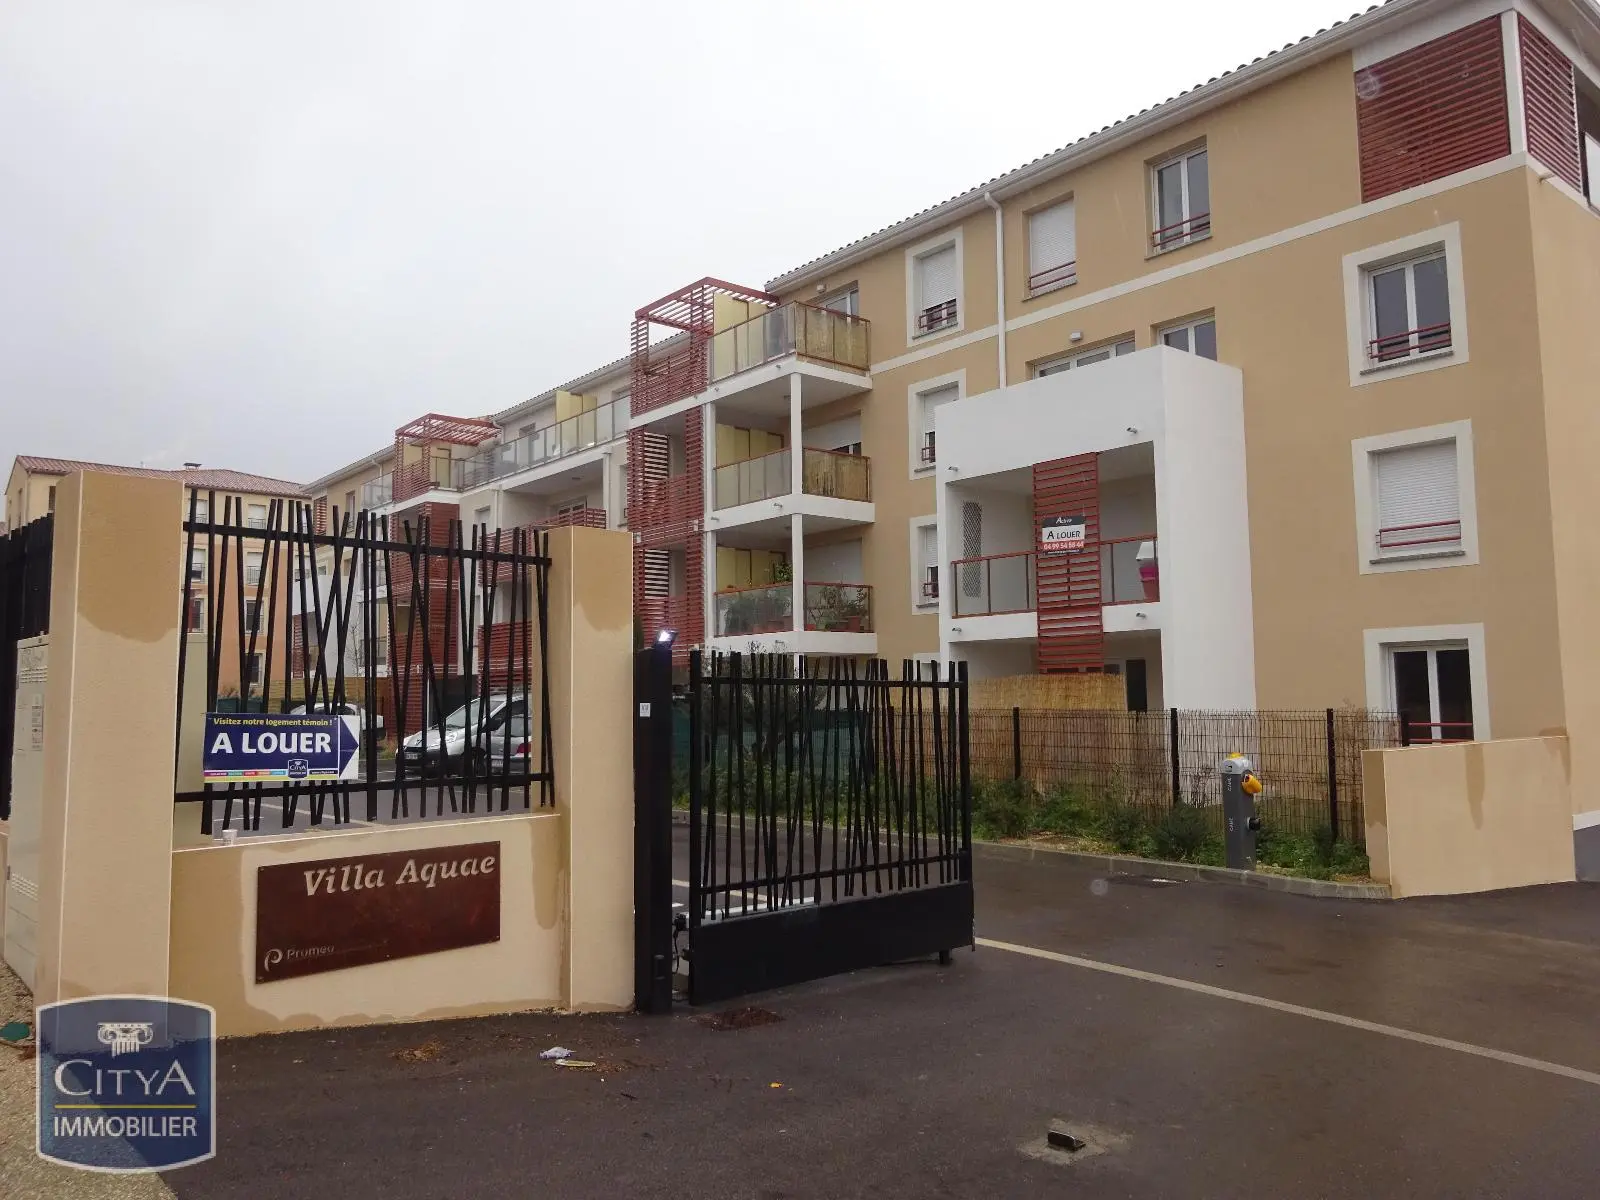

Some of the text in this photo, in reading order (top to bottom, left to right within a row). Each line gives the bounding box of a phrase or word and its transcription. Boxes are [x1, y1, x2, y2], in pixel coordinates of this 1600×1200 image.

[1046, 531, 1081, 540] A LOUER
[213, 717, 241, 725] Visitez
[243, 718, 264, 726] notre
[266, 718, 301, 727] logement
[302, 718, 328, 726] témoin
[211, 732, 332, 754] A LOUER
[303, 855, 496, 896] Villa Aquae
